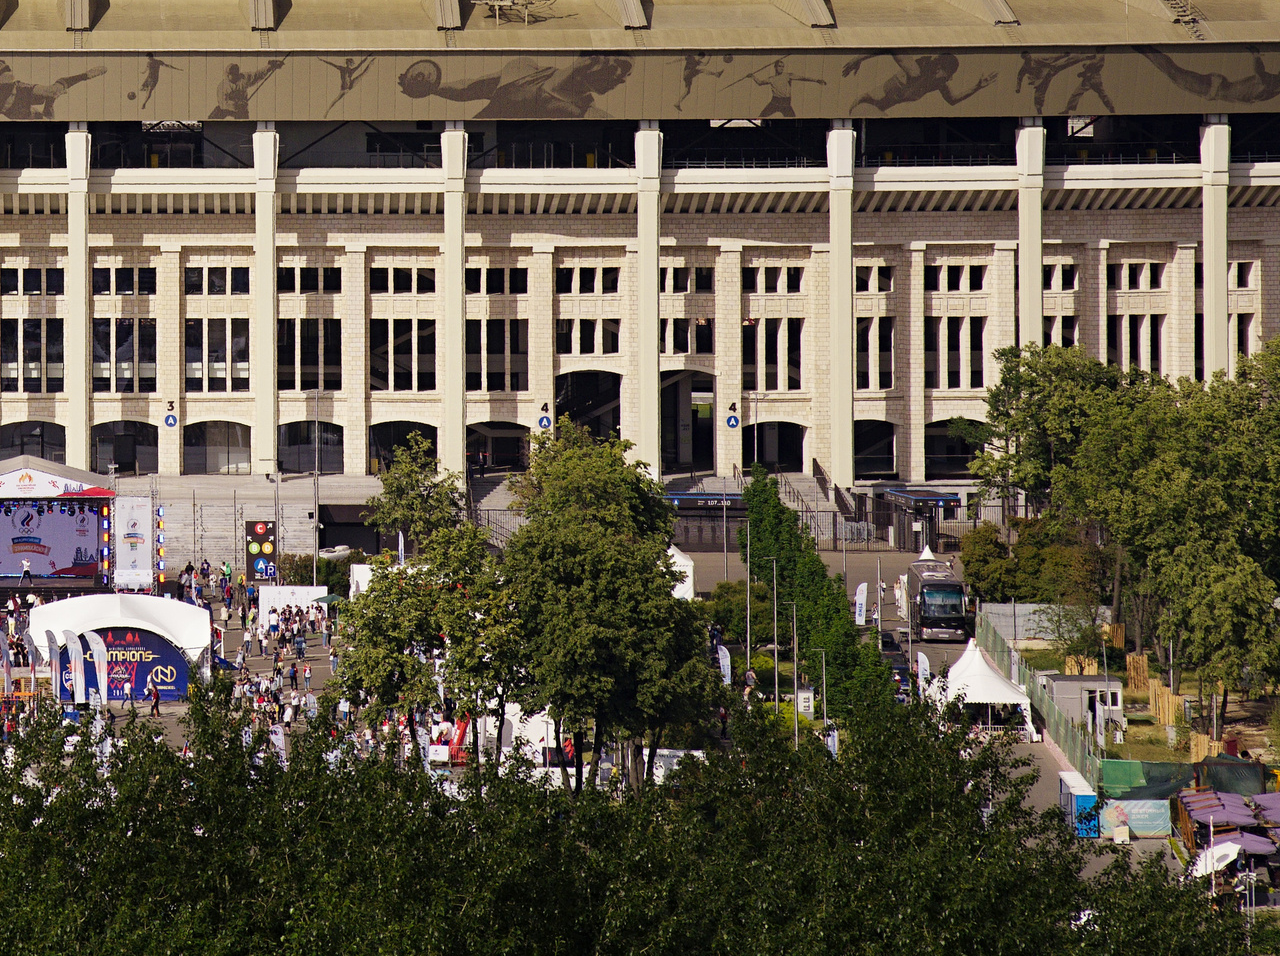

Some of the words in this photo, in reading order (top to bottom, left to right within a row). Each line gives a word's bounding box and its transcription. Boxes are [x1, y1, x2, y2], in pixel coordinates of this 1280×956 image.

[167, 401, 174, 411] 3
[541, 402, 549, 413] 4
[729, 402, 737, 413] 4
[167, 416, 175, 425] A
[541, 417, 549, 426] A
[729, 417, 737, 426] A
[257, 525, 264, 533] C
[251, 544, 257, 552] B
[264, 544, 271, 552] D
[257, 560, 266, 570] A
[267, 566, 275, 576] P
